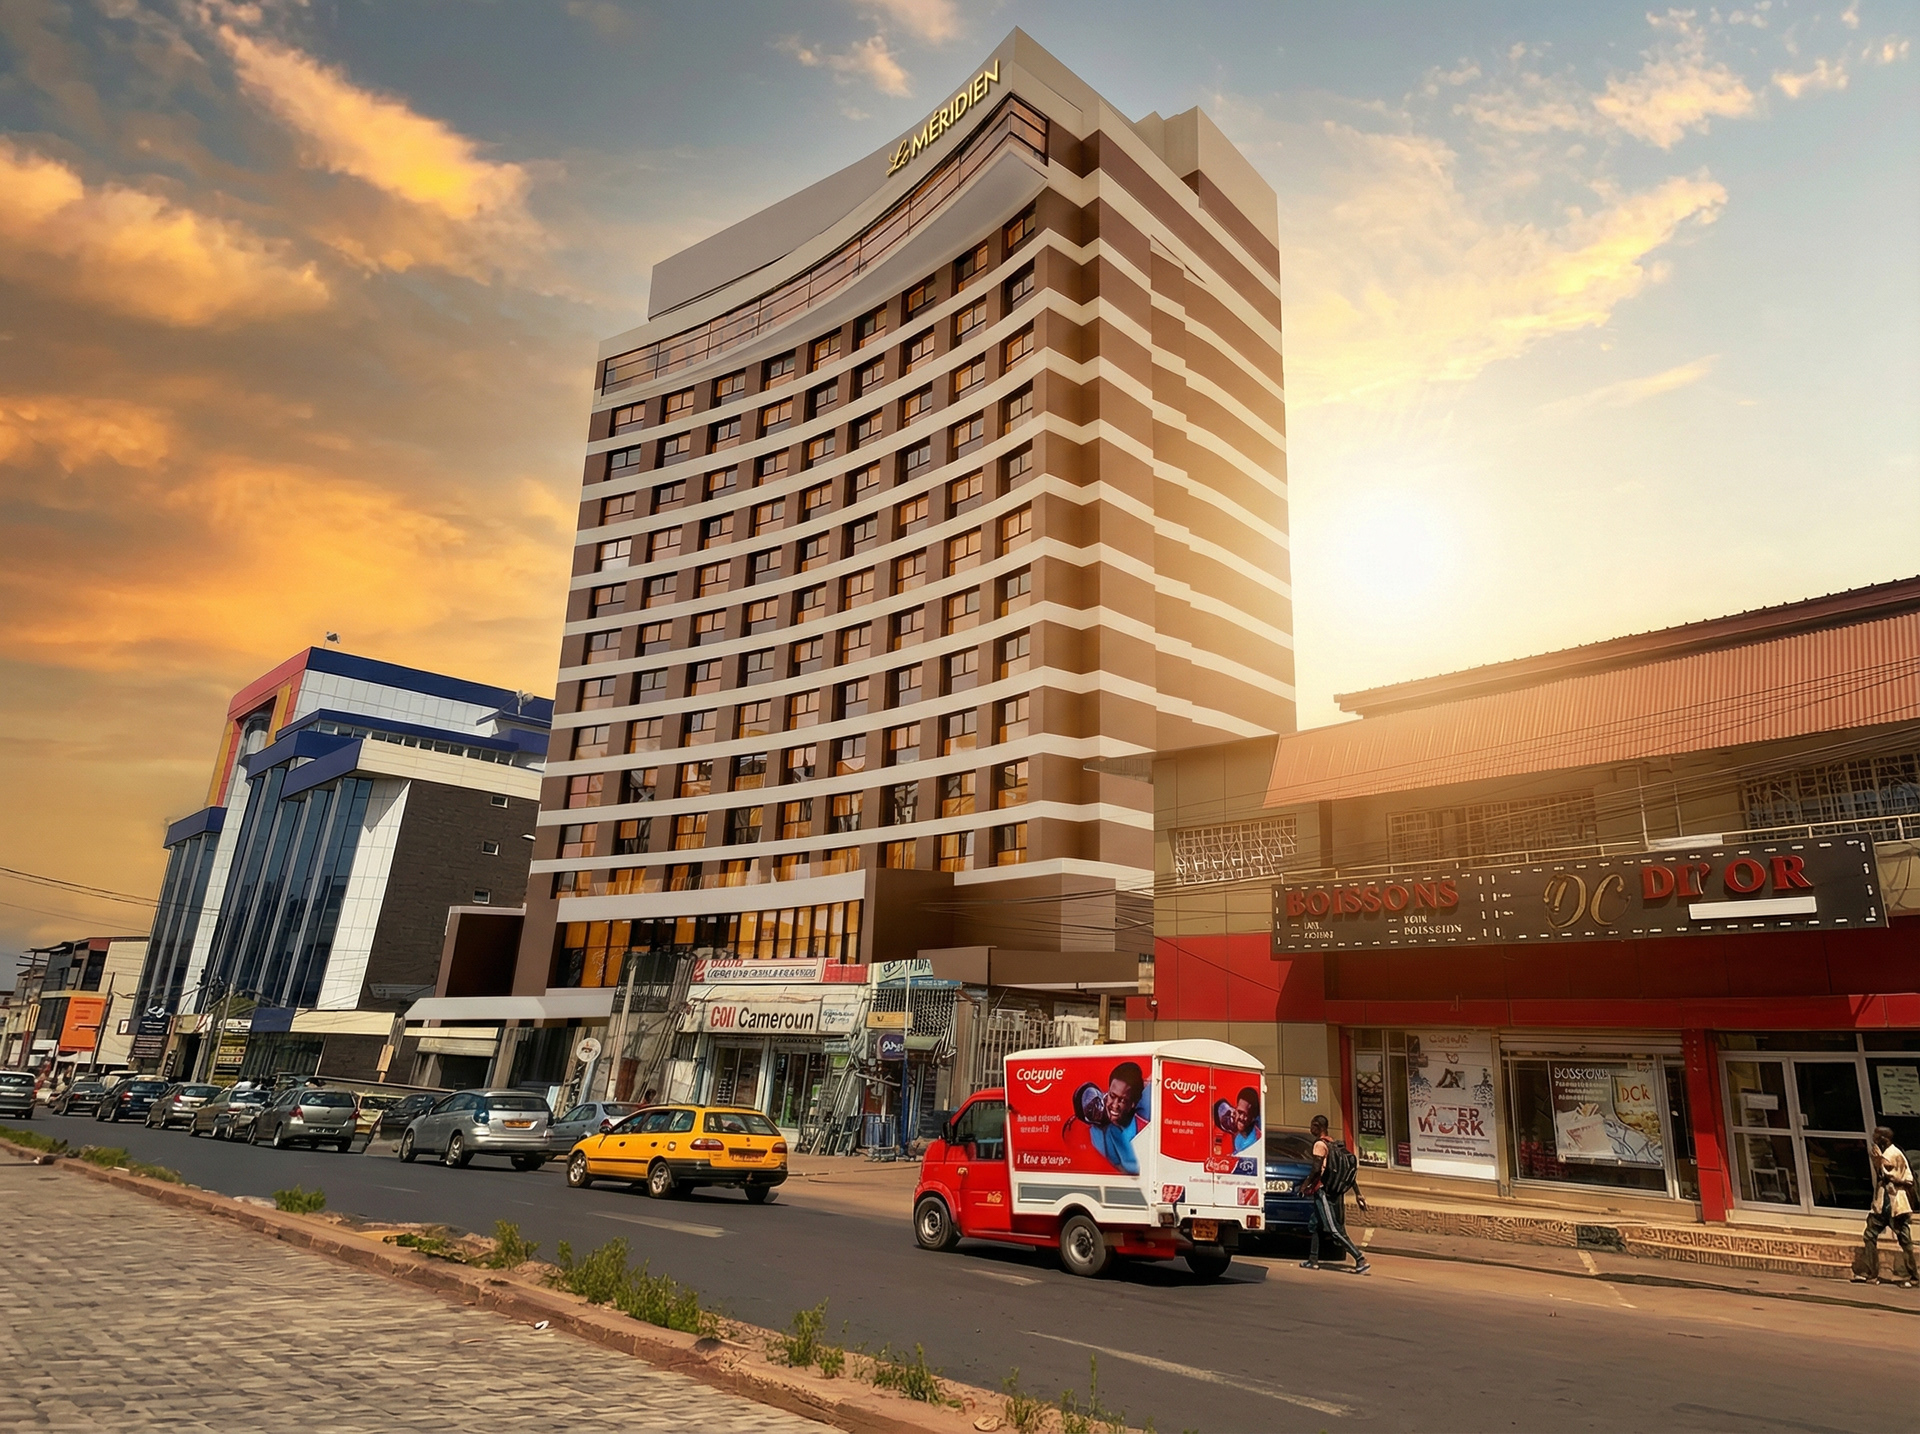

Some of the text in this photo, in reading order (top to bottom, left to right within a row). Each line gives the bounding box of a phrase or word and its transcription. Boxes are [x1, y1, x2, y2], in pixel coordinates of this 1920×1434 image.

[911, 58, 1000, 158] MÉRIDIEN
[1286, 879, 1459, 917] BOISSONS
[738, 1007, 814, 1030] Cameroun
